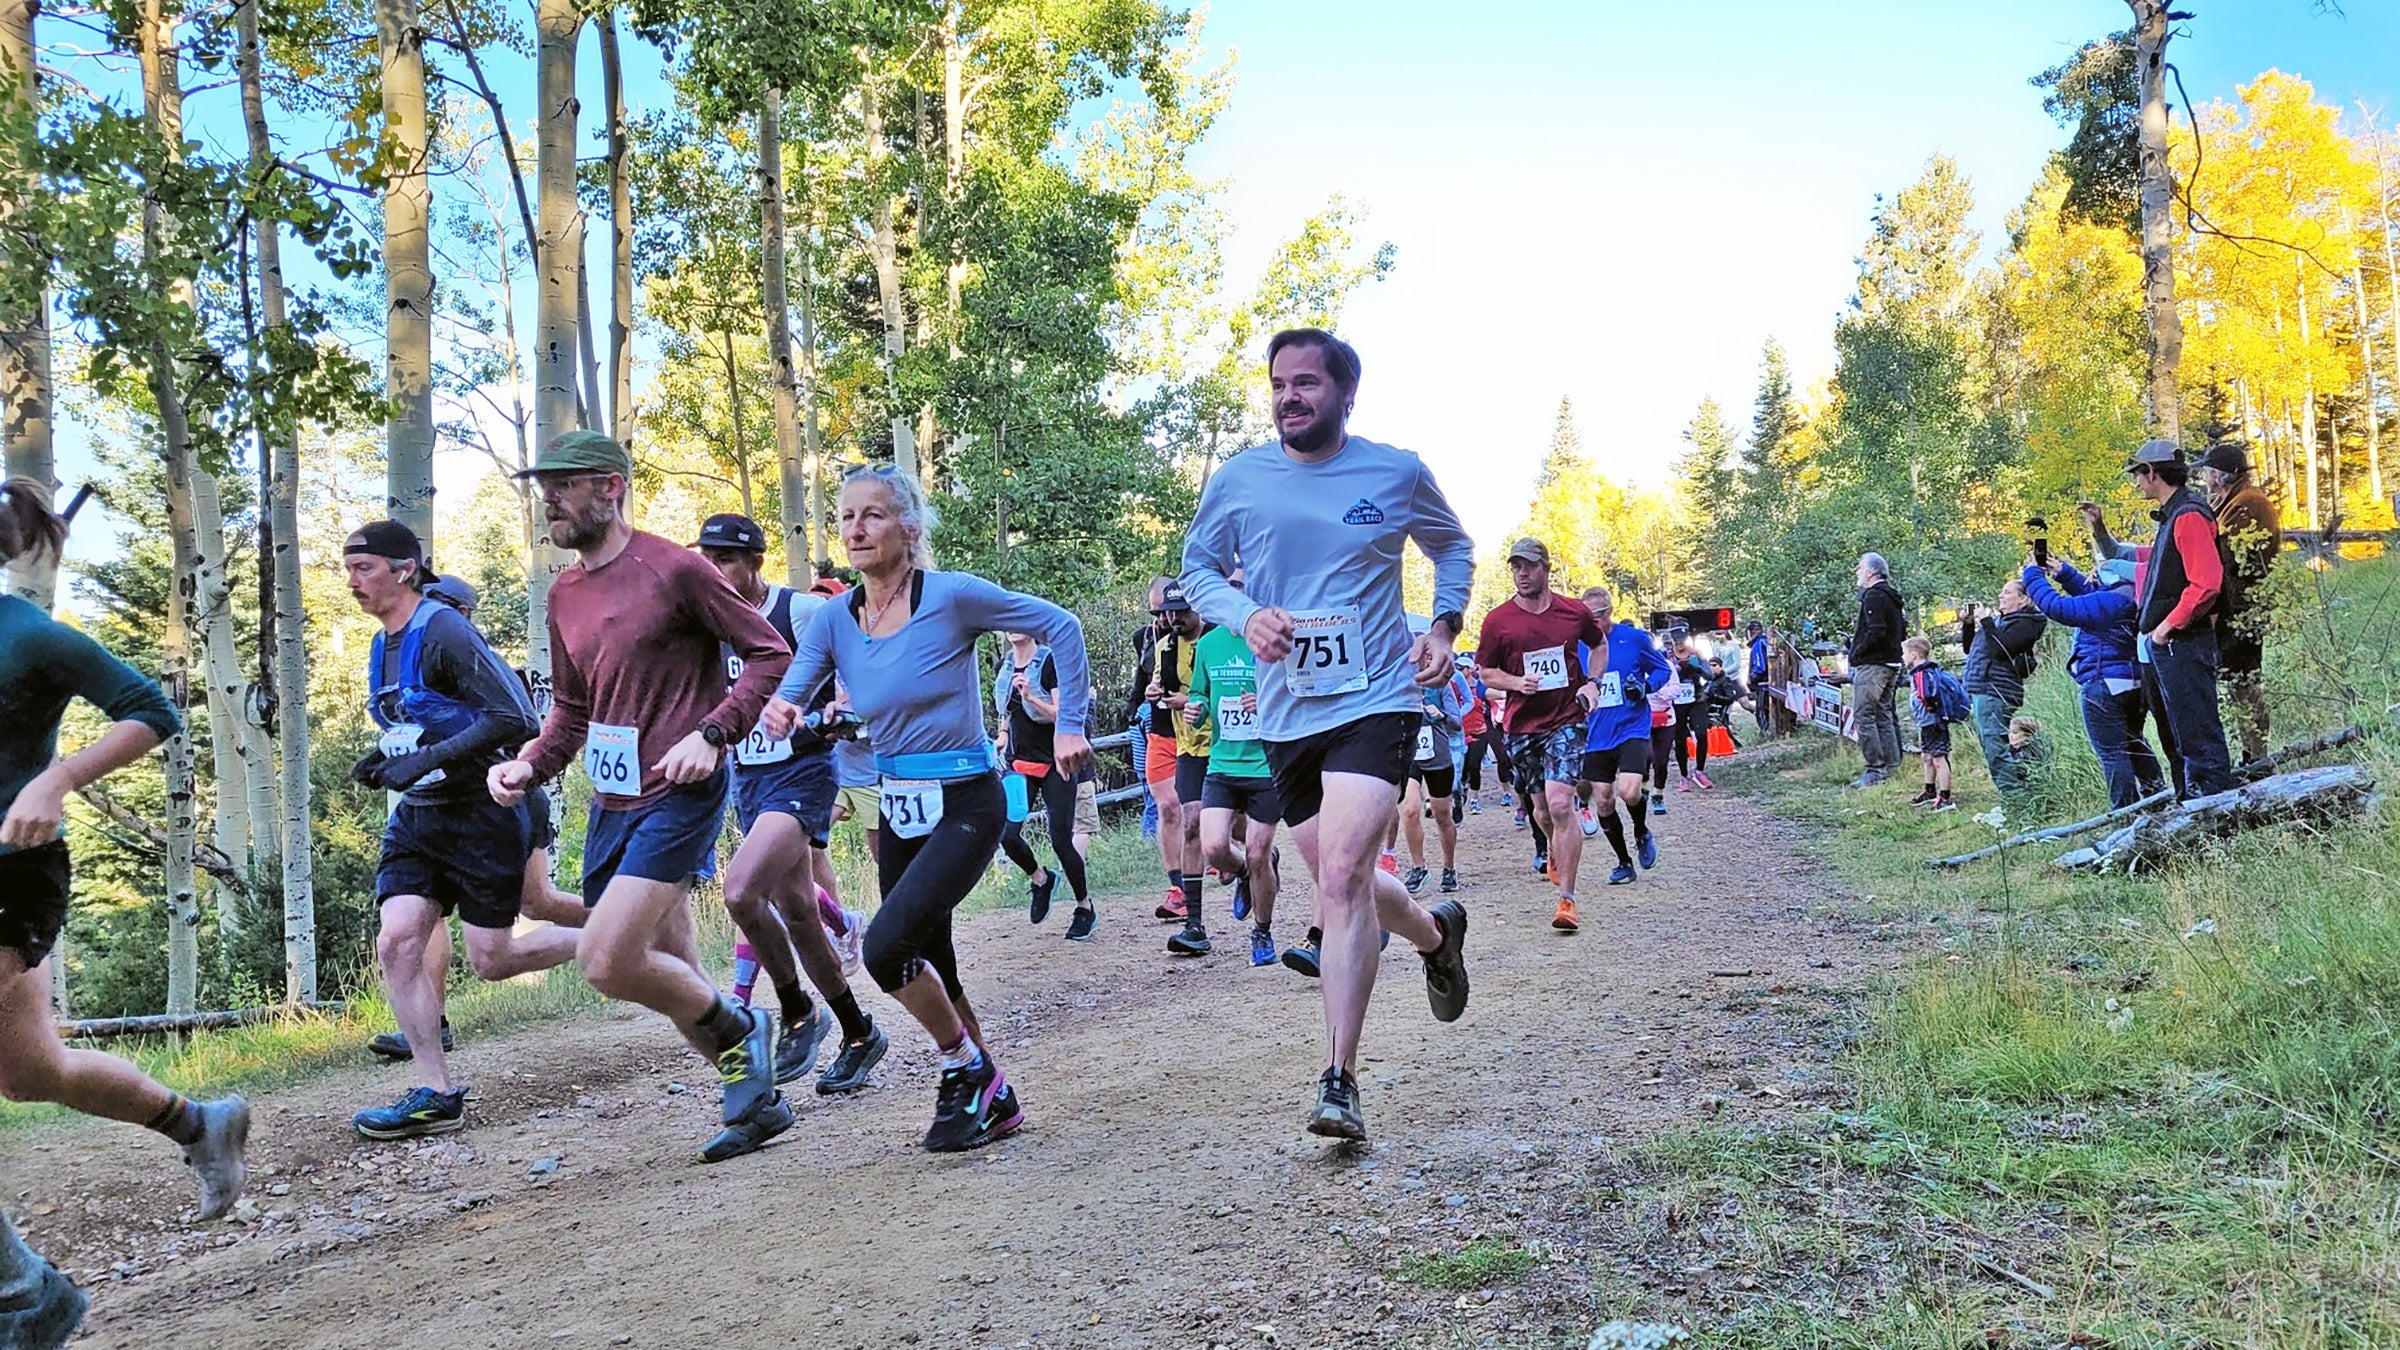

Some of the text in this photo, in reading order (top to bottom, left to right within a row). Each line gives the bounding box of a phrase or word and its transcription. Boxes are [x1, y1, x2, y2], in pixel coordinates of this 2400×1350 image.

[1294, 632, 1350, 669] 751
[1530, 659, 1561, 676] 740
[1221, 707, 1252, 727] 732
[591, 748, 628, 783] 766
[884, 792, 928, 827] 731
